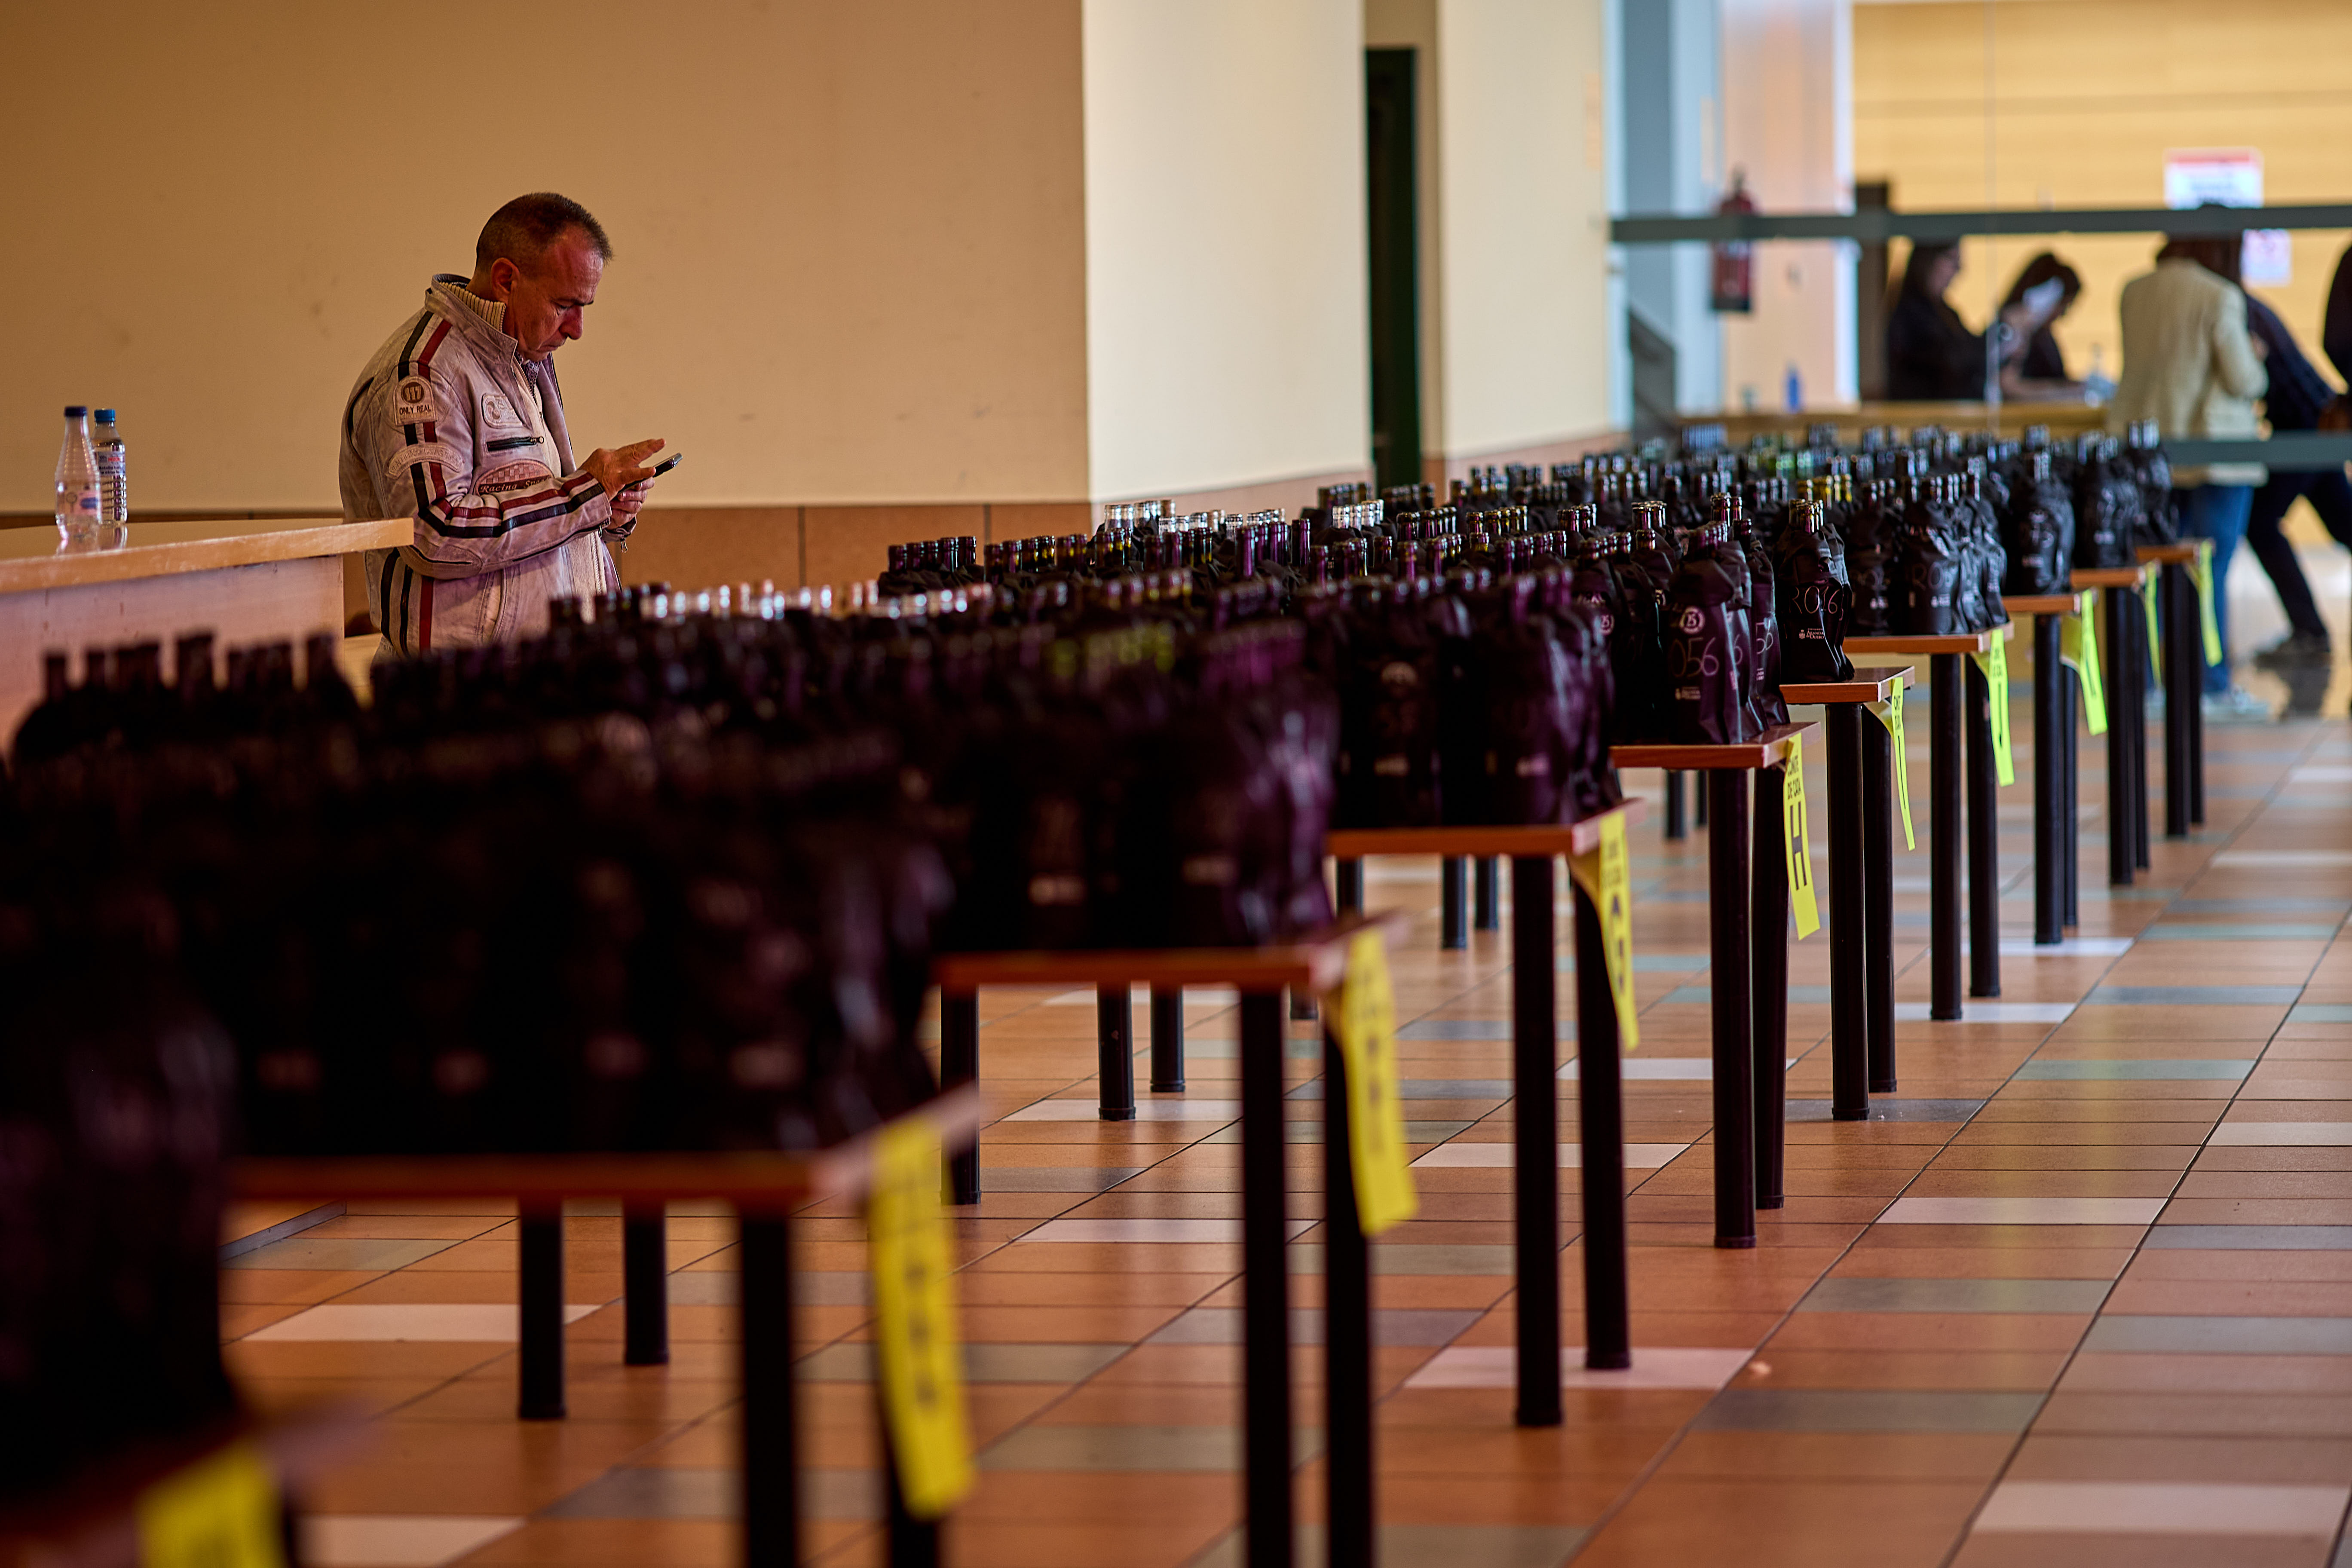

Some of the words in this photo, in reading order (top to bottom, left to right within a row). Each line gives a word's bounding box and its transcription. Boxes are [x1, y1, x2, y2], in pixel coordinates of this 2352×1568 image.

[399, 406, 413, 415] ONLY
[416, 404, 431, 413] REAL
[481, 484, 517, 493] Racing
